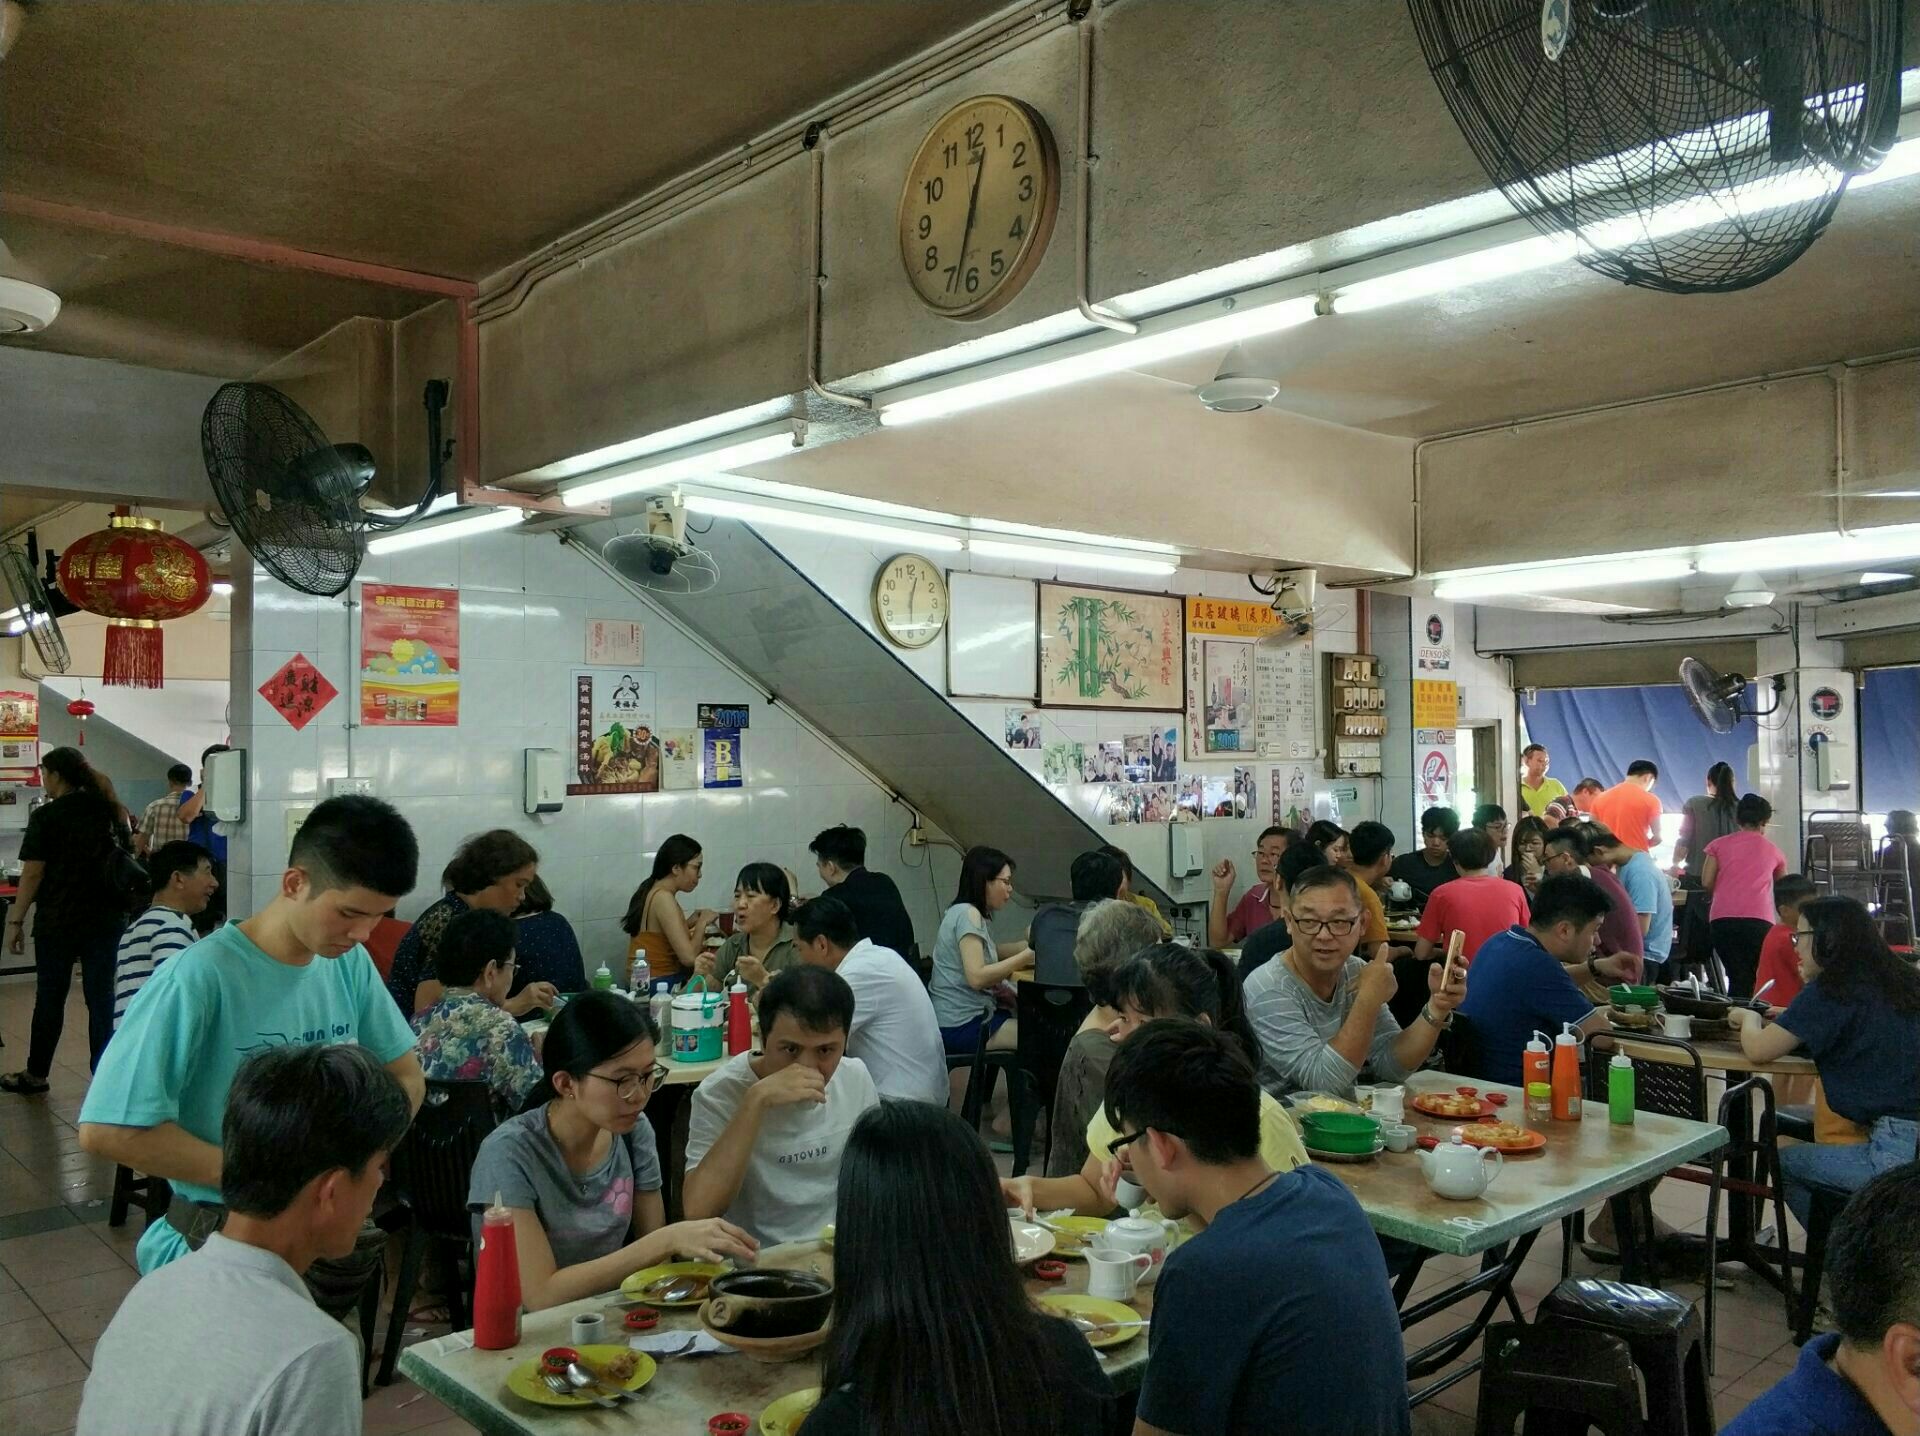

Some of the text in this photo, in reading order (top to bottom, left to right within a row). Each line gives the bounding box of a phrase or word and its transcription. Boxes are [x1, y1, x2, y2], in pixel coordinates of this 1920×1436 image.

[965, 122, 984, 150] 12
[996, 124, 1004, 148] 1
[943, 142, 958, 169] 11
[1012, 141, 1026, 169] 2
[924, 176, 944, 204] 10
[1018, 175, 1033, 201] 3
[918, 215, 932, 240] 9
[1008, 215, 1024, 241] 4
[925, 245, 938, 271] 8
[990, 250, 1005, 276] 5
[944, 265, 956, 293] 7
[965, 267, 979, 293] 6
[895, 567, 903, 579] 11
[906, 564, 916, 576] 12
[921, 570, 925, 580] 1
[885, 580, 896, 591] 10
[928, 582, 935, 593] 2
[882, 594, 890, 606] 9
[931, 598, 938, 609] 3
[1420, 649, 1442, 659] DENSO
[714, 709, 747, 728] 2018
[1807, 724, 1833, 736] DENSO
[714, 741, 732, 764] B
[303, 1029, 325, 1043] run
